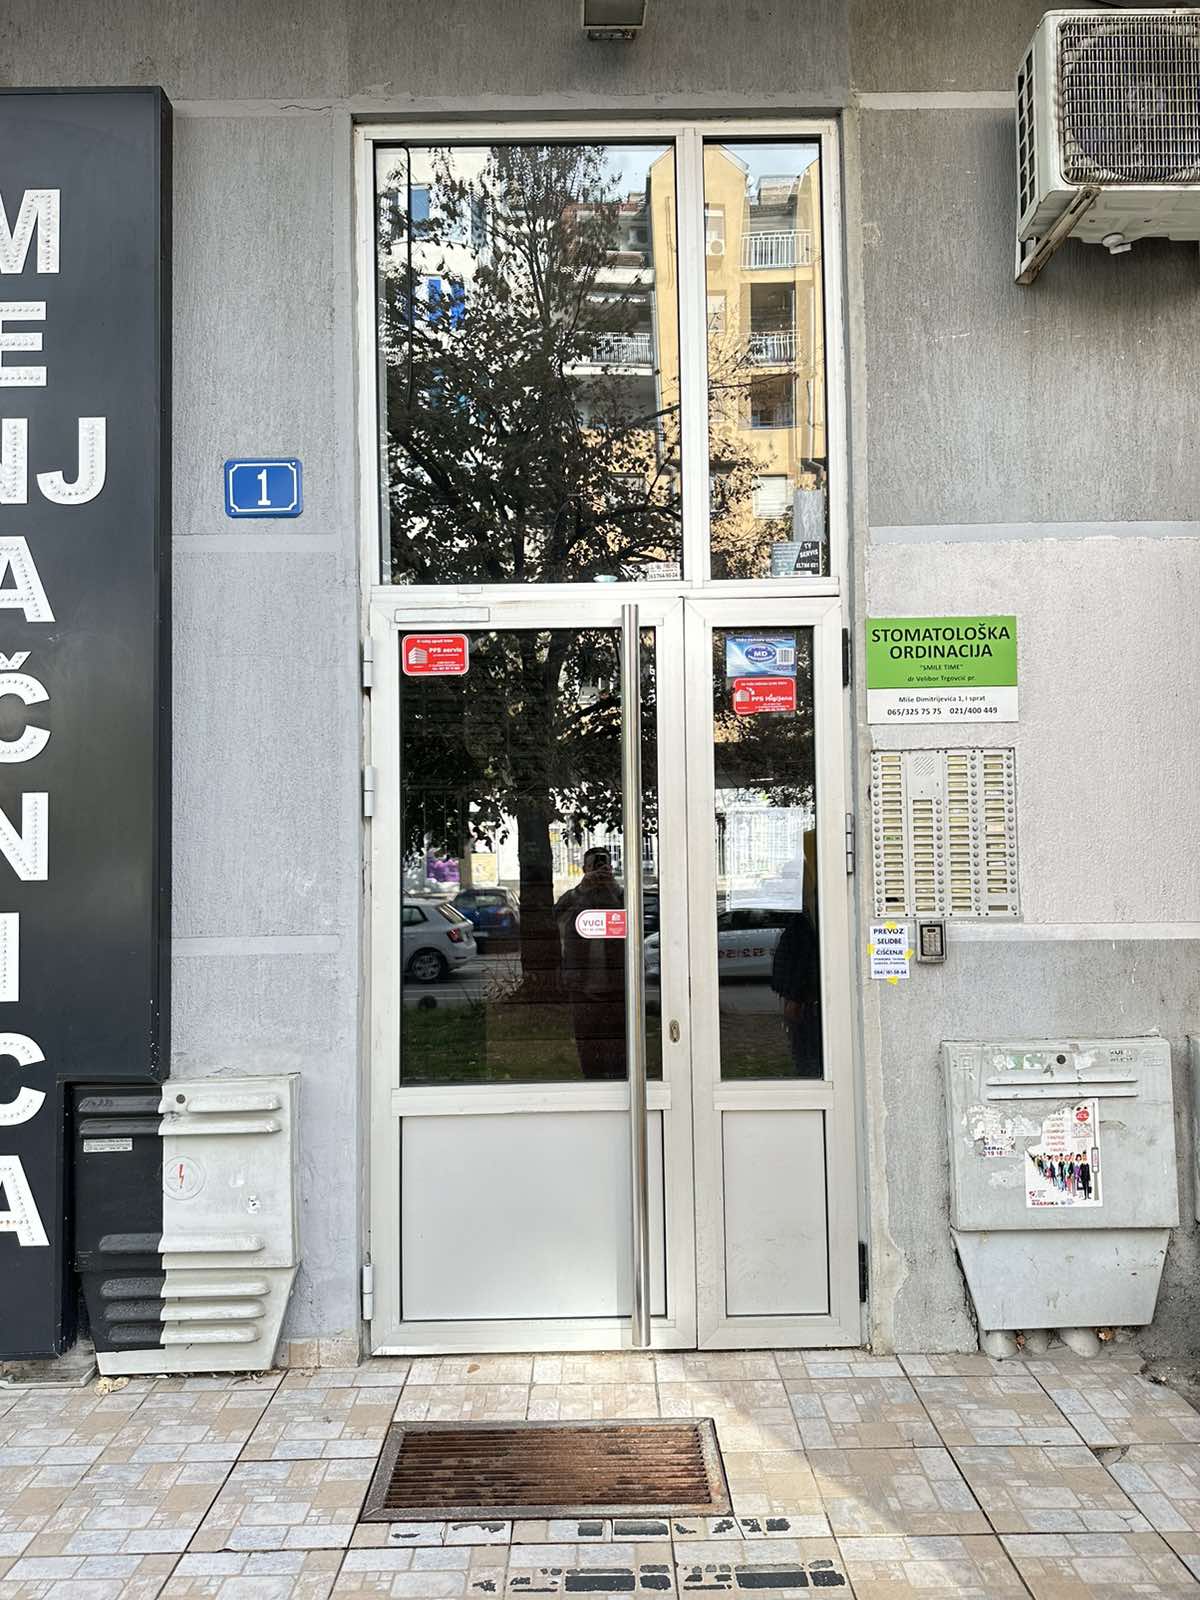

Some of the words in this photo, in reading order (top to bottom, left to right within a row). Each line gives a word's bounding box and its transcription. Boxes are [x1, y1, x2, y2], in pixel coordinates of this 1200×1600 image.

[256, 468, 272, 506] 1
[871, 623, 1010, 643] STOMATOLOŠKA
[889, 643, 993, 660] ORDINACIJA
[968, 695, 986, 704] sprat
[887, 708, 919, 716] 065/325
[921, 707, 931, 715] 75
[932, 707, 942, 715] 75
[949, 706, 982, 715] 021/400
[983, 706, 998, 714] 449
